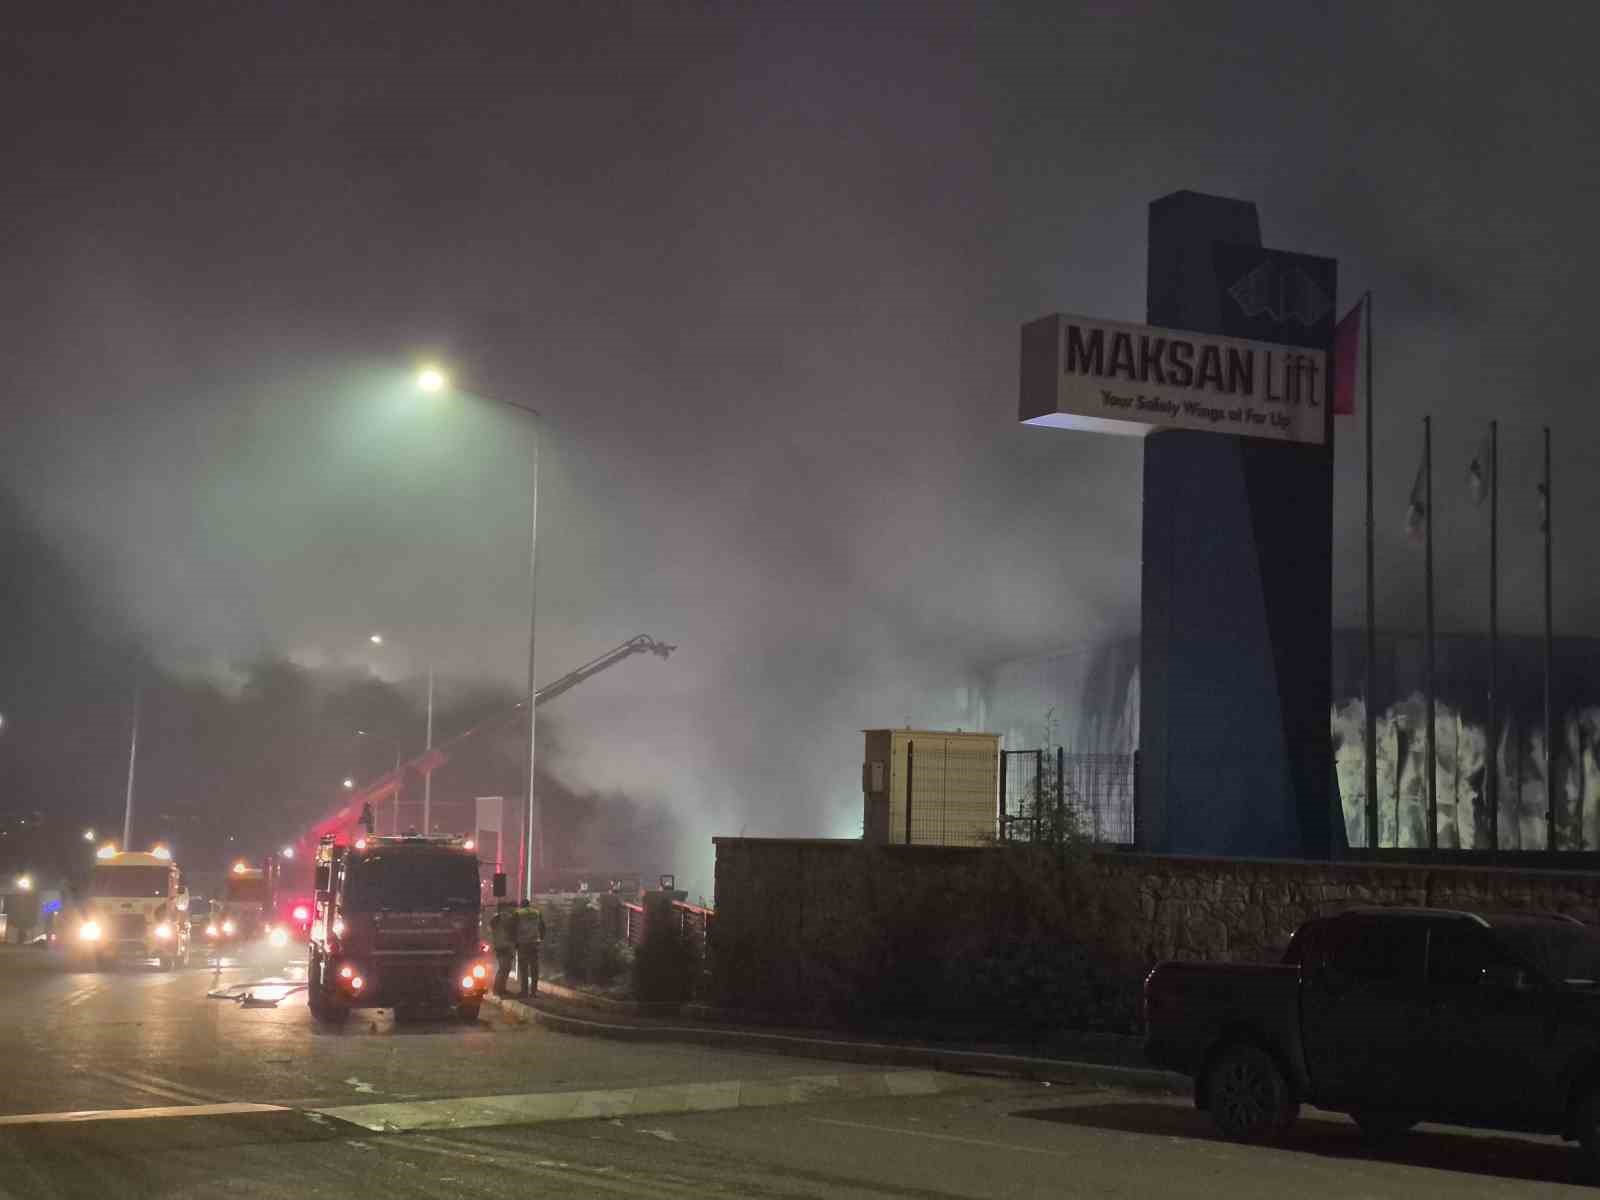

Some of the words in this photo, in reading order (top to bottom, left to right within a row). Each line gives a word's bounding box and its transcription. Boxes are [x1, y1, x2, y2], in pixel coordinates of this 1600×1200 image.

[1065, 325, 1252, 395] MAKSAN
[1265, 351, 1320, 407] Lift
[1100, 389, 1134, 408] Your
[1137, 395, 1179, 417] Safety
